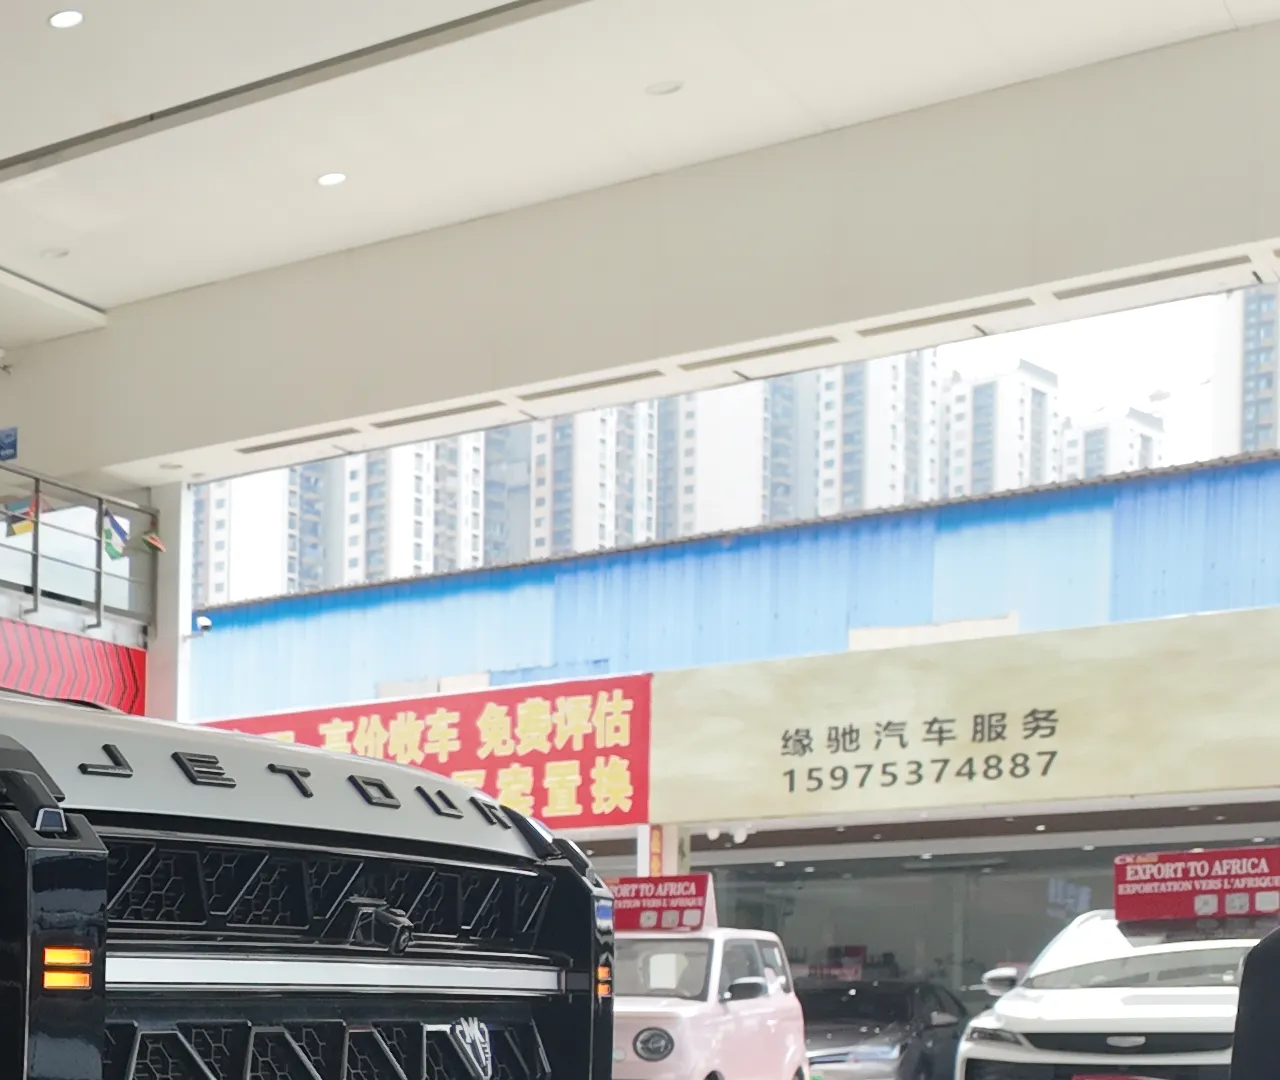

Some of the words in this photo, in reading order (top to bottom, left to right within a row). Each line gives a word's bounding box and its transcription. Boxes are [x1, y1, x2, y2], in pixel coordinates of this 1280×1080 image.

[476, 688, 634, 760] 免费评估
[780, 708, 1059, 758] 缘驰汽车服务
[77, 743, 513, 830] JETOUR
[782, 750, 1058, 794] 15975374887
[639, 883, 655, 897] TO
[655, 881, 697, 897] AFRICA
[1125, 862, 1186, 881] EXPORT
[1187, 860, 1209, 877] TO
[1210, 857, 1270, 876] AFRICA
